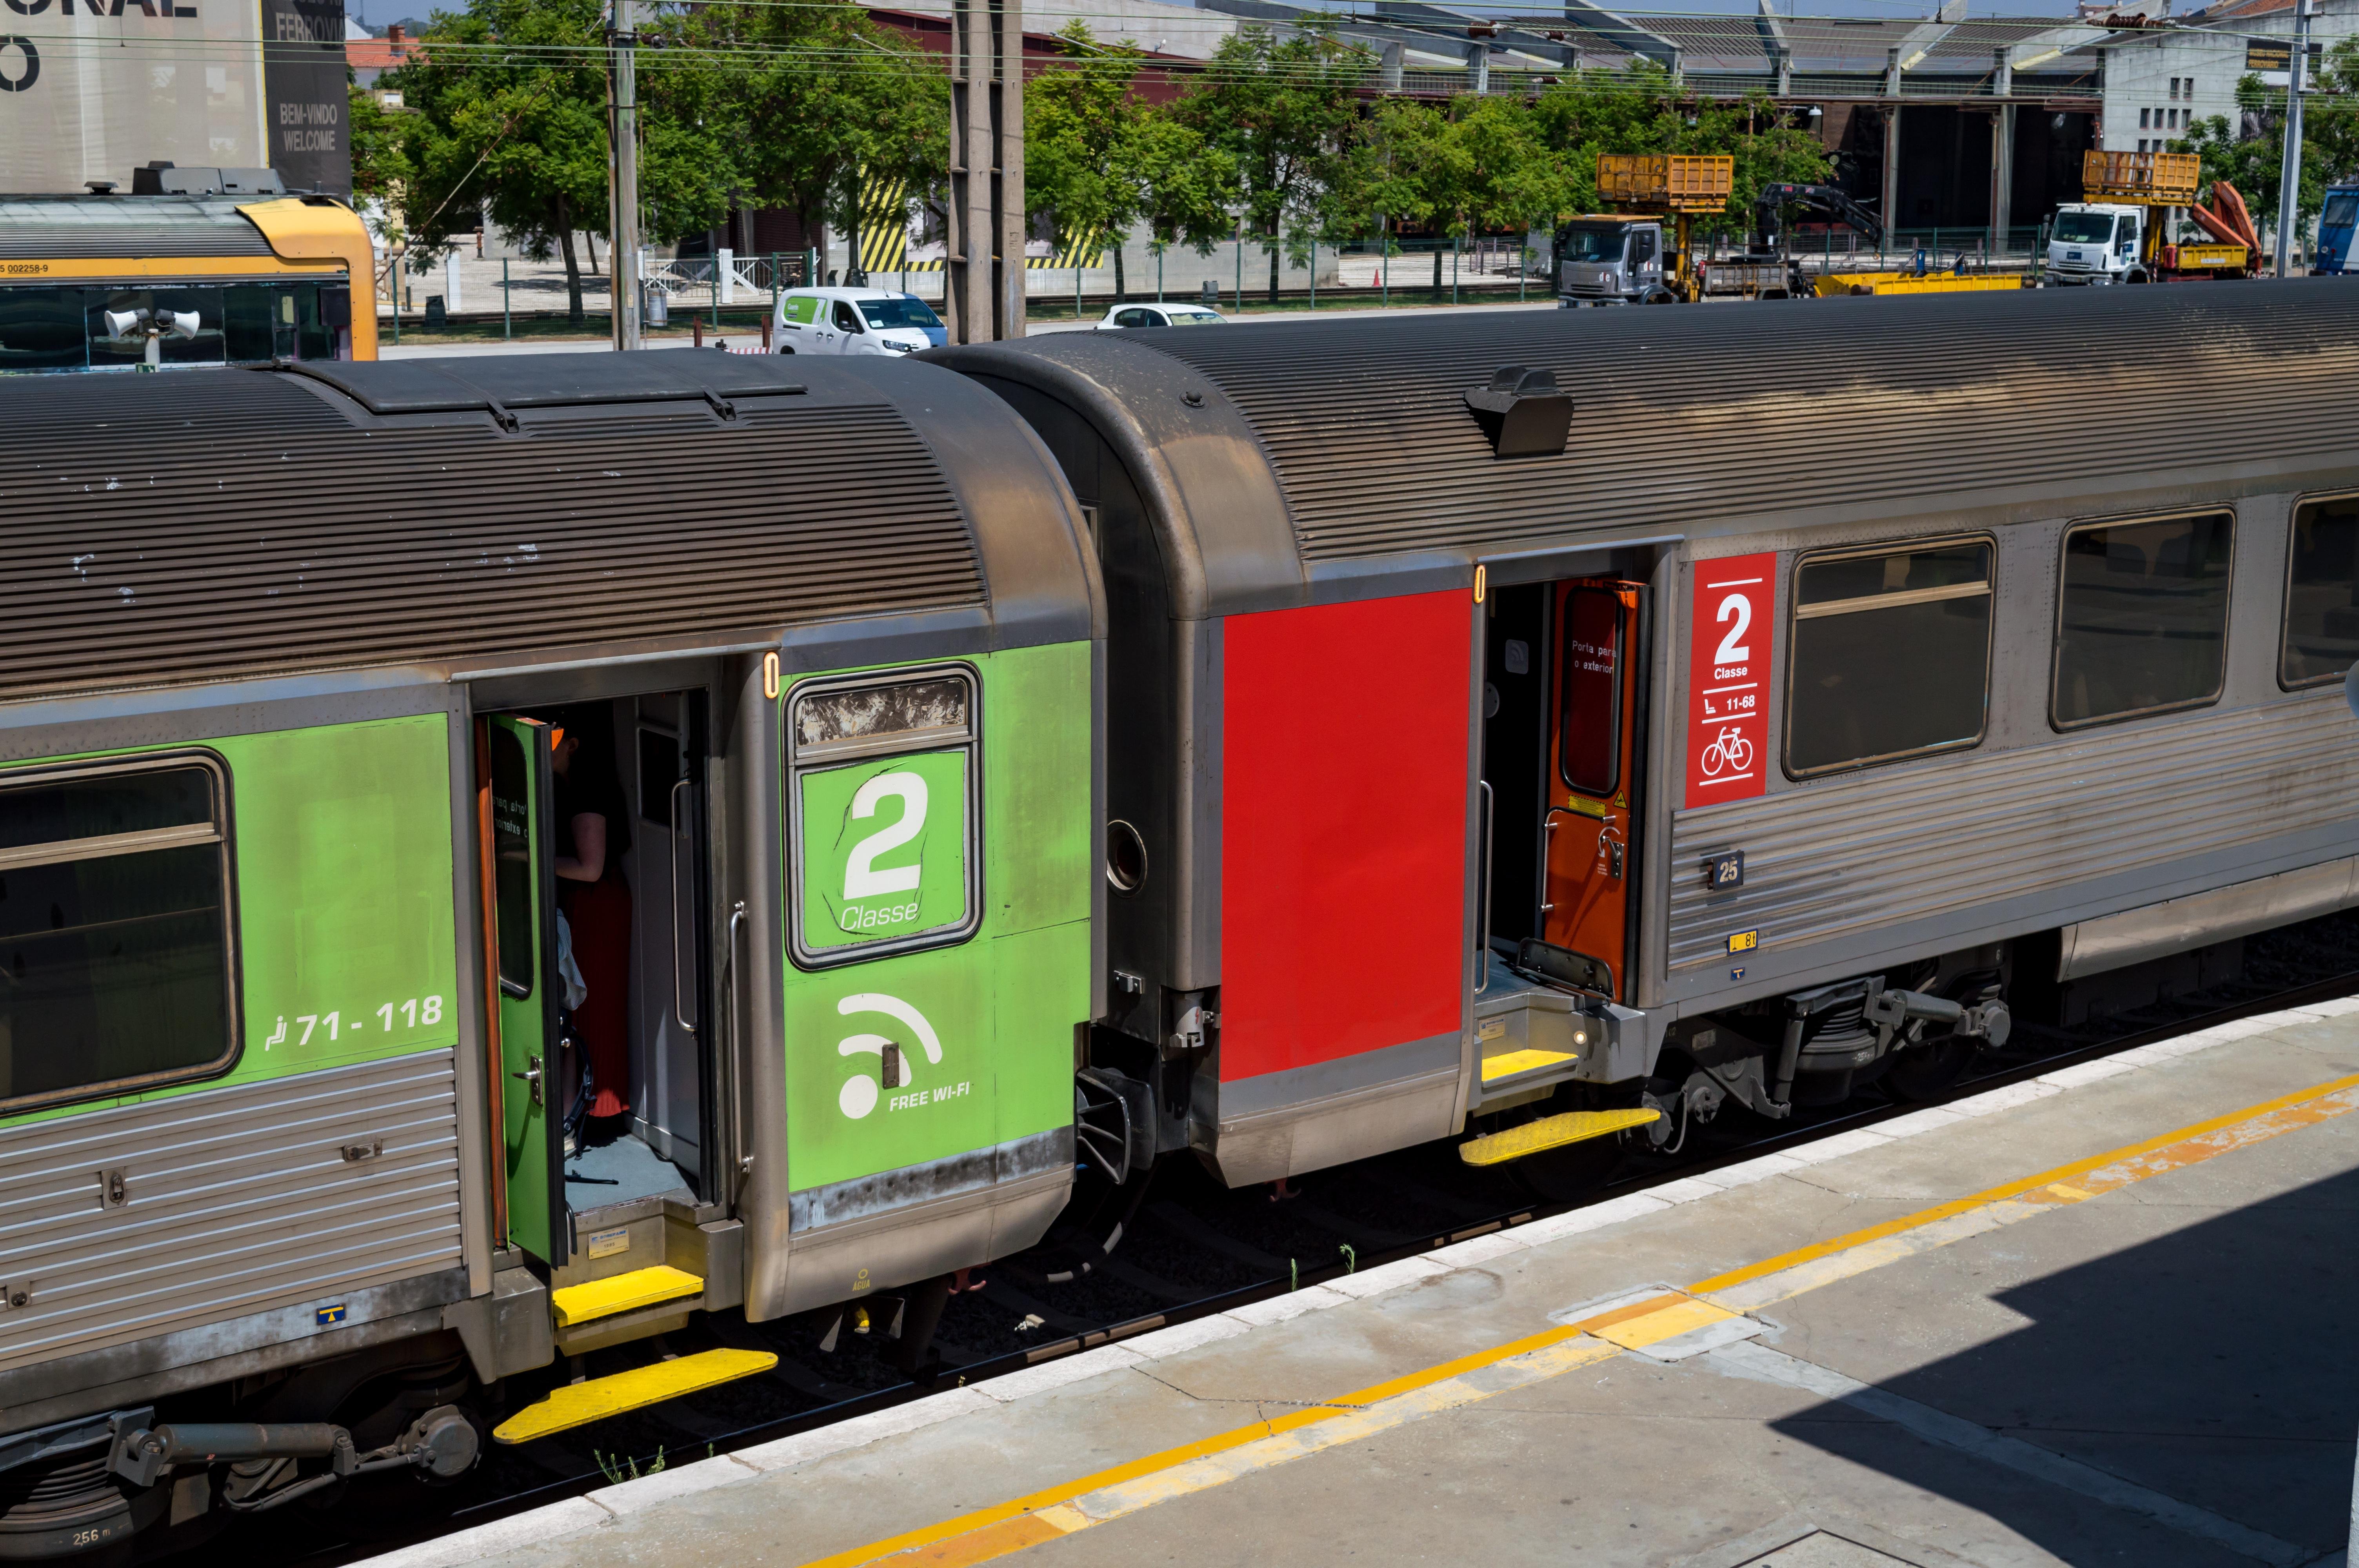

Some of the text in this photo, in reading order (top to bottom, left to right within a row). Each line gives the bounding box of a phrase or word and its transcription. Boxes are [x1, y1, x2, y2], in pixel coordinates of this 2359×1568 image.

[280, 103, 337, 125] BEM-VINDO
[284, 131, 336, 152] WELCOME
[8, 264, 48, 272] 002258-9
[1714, 593, 1751, 665] 2
[1572, 640, 1616, 657] Porta para
[1583, 661, 1613, 674] exterior
[1714, 666, 1748, 680] Classe
[1727, 695, 1755, 711] 11-68
[843, 771, 928, 900] 2
[1719, 860, 1738, 882] 25
[841, 902, 918, 931] Classe
[296, 1011, 340, 1046] 71
[376, 995, 442, 1032] 118
[890, 1081, 970, 1112] FREE WI-FI
